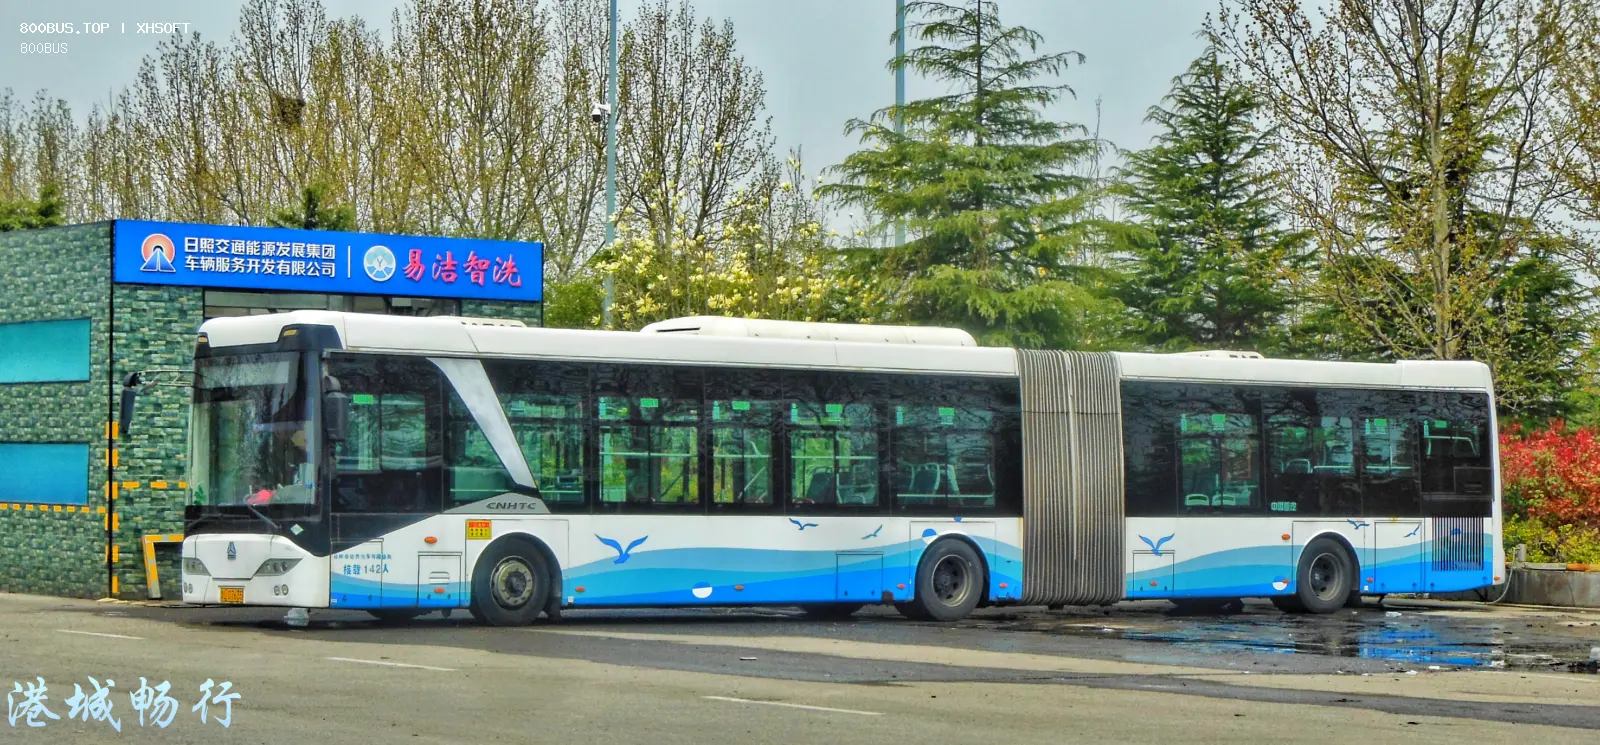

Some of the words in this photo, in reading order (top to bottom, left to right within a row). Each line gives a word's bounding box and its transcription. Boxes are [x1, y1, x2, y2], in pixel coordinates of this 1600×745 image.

[184, 237, 335, 260] 日照交通能源发展集团
[184, 255, 336, 278] 车辆服务开发有限公司
[403, 248, 522, 287] 易洁智洗
[486, 502, 537, 510] CNHTC
